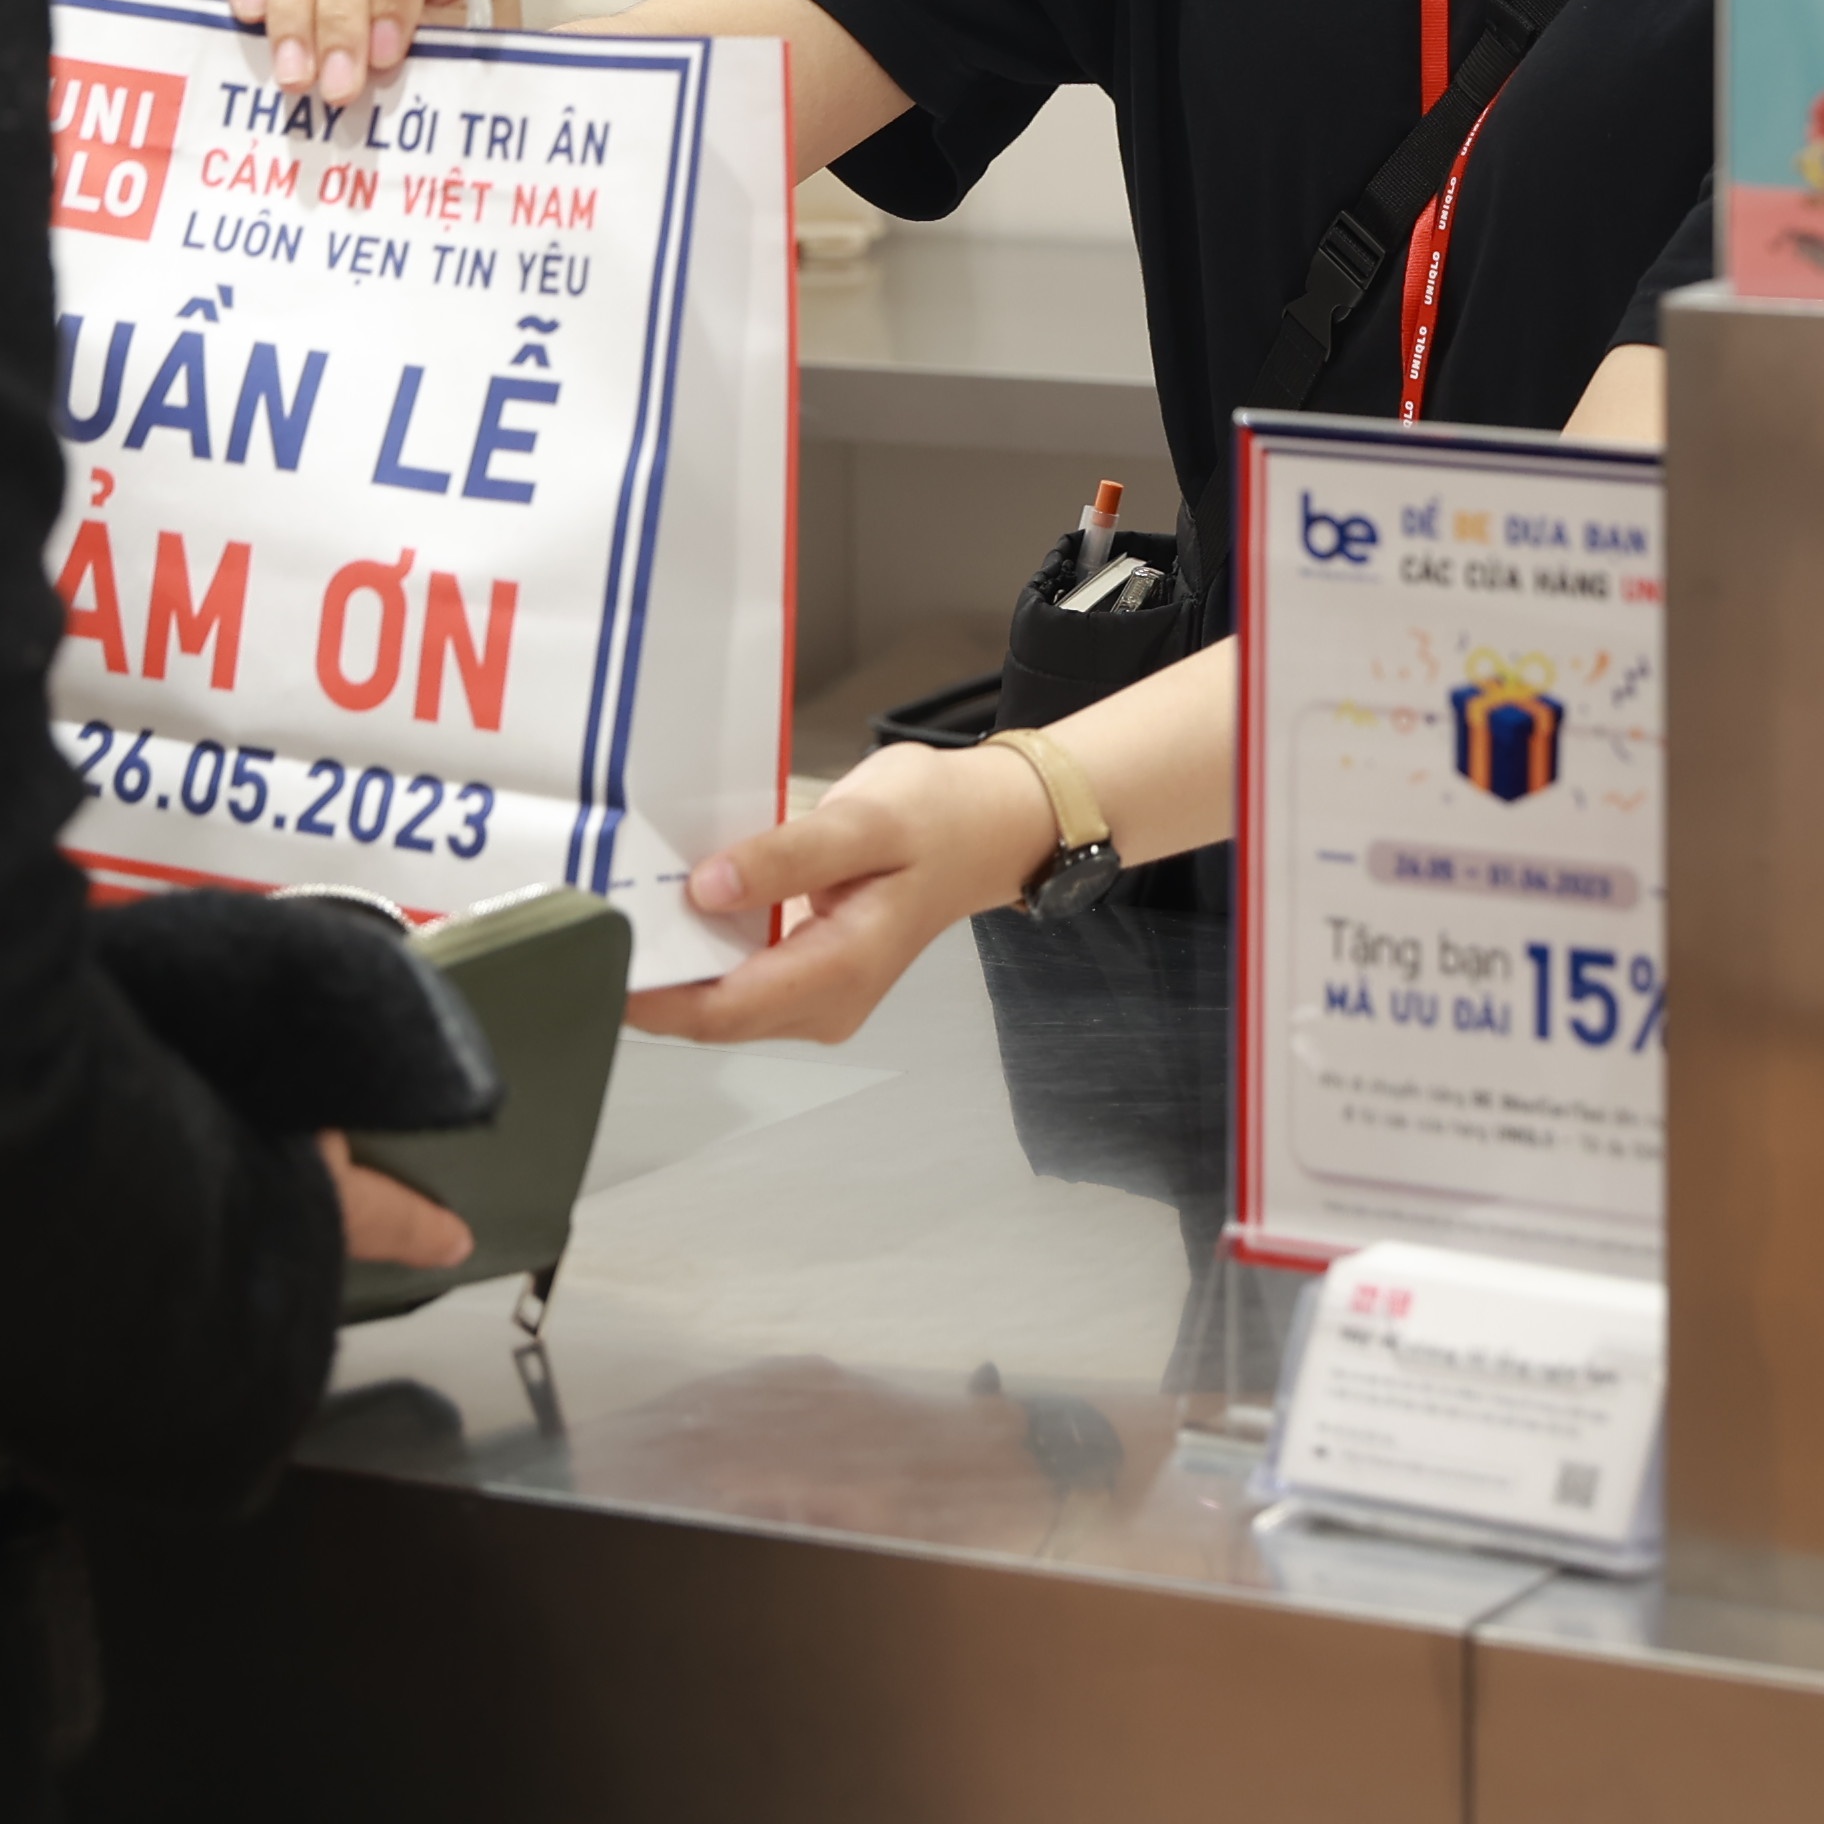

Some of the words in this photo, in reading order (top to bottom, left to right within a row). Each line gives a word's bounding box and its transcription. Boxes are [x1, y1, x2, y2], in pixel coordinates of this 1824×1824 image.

[49, 77, 155, 149] UNI
[220, 81, 344, 144] THAY
[366, 93, 439, 155] LỜI
[459, 112, 528, 162] TRI
[547, 105, 611, 167] ÂN
[54, 150, 149, 219] LO
[200, 138, 299, 198] CẢM
[318, 160, 380, 211] ƠN
[404, 167, 494, 232] VIỆT
[511, 184, 598, 231] NAM
[1438, 176, 1457, 230] UNIQLO
[182, 208, 304, 264] LUÔN
[327, 231, 411, 286] VẸN
[433, 245, 497, 290] TIN
[518, 241, 591, 297] YÊU
[1424, 251, 1441, 305] UNIQLO
[1410, 326, 1428, 380] UNIQLO
[55, 284, 329, 473] UẦN
[371, 314, 562, 505] LỄ
[1403, 400, 1414, 428] QLO
[1301, 489, 1378, 563] be
[55, 467, 253, 692] ẢM
[315, 547, 519, 733] ƠN
[1621, 575, 1663, 604] UNI
[1326, 916, 1422, 980] Tặng
[1439, 928, 1512, 982] bạn
[1527, 943, 1664, 1054] 15%
